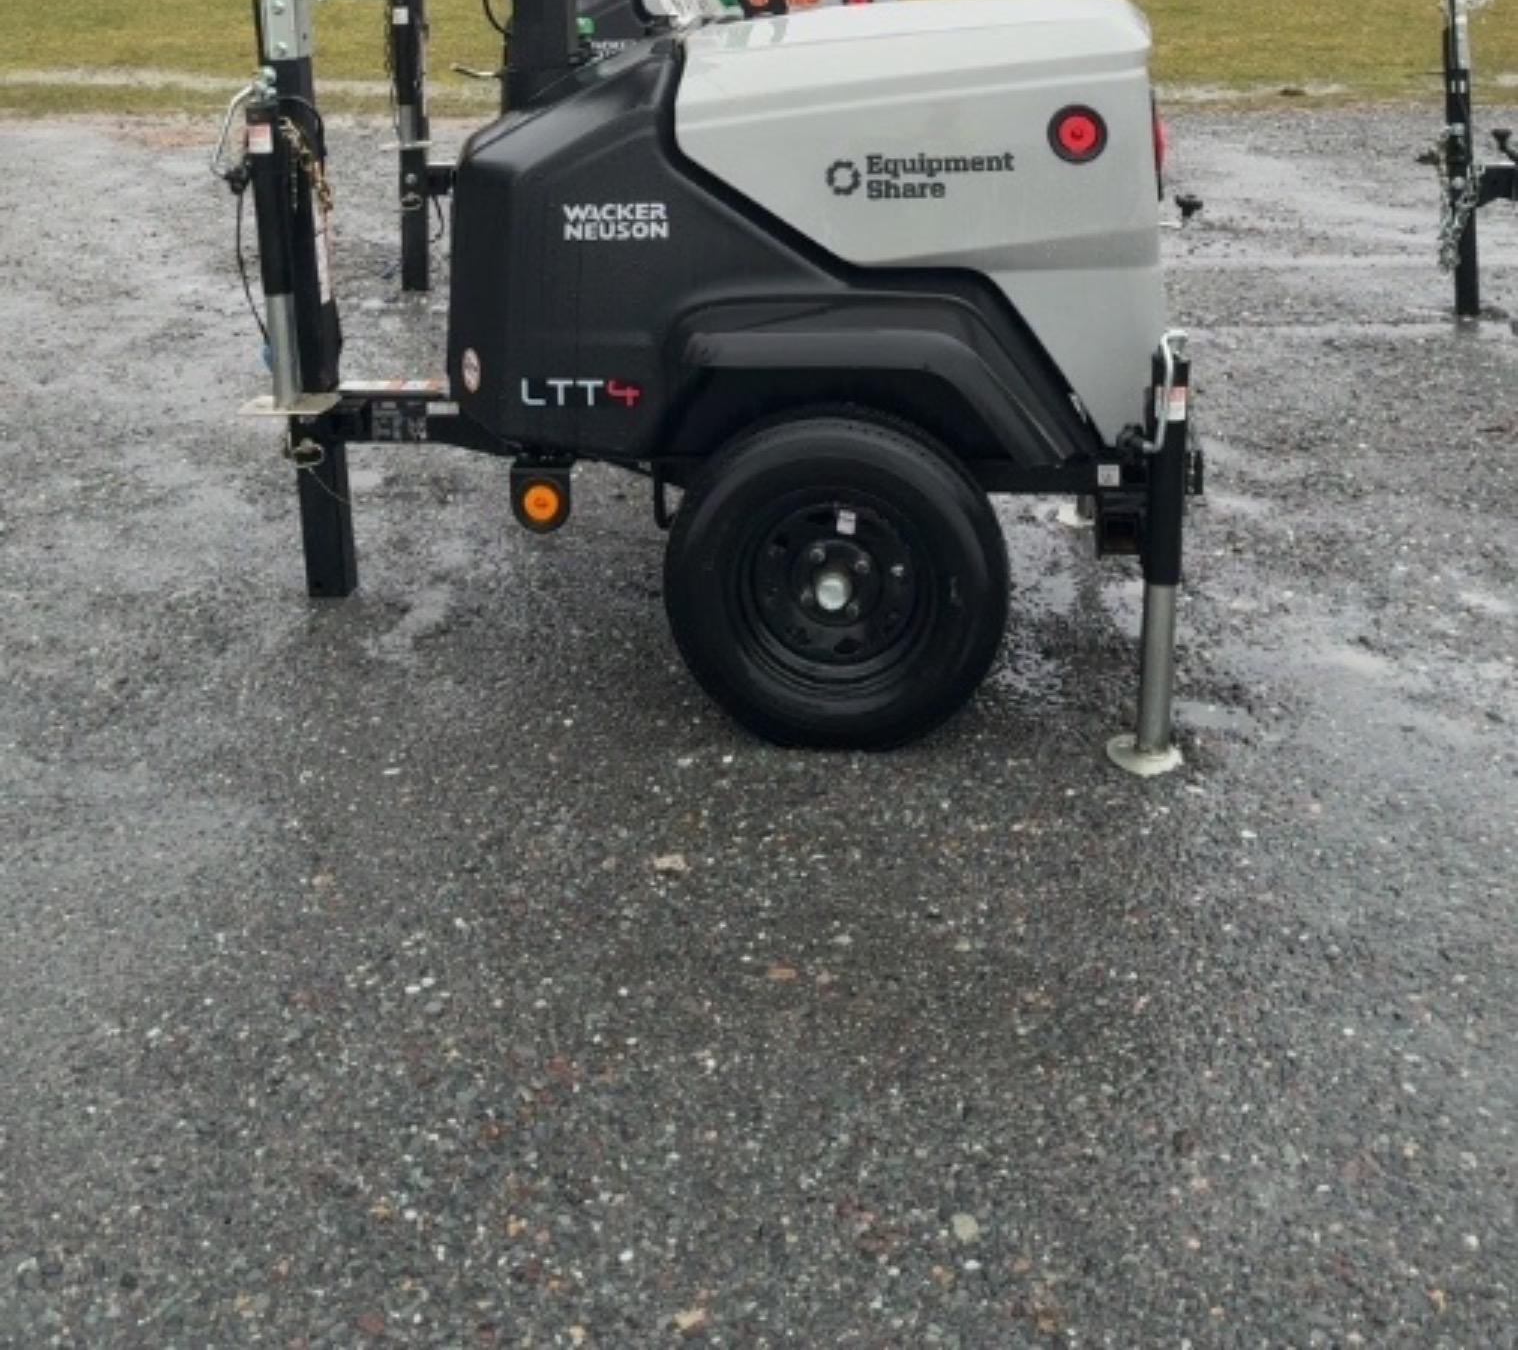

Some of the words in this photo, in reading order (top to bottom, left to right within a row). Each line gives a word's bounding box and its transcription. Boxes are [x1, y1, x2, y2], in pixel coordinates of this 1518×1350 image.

[866, 152, 1014, 179] Equipment
[866, 179, 946, 200] Share
[562, 203, 668, 220] WACKER
[563, 221, 670, 241] NEUSON
[520, 378, 640, 407] LTT4
